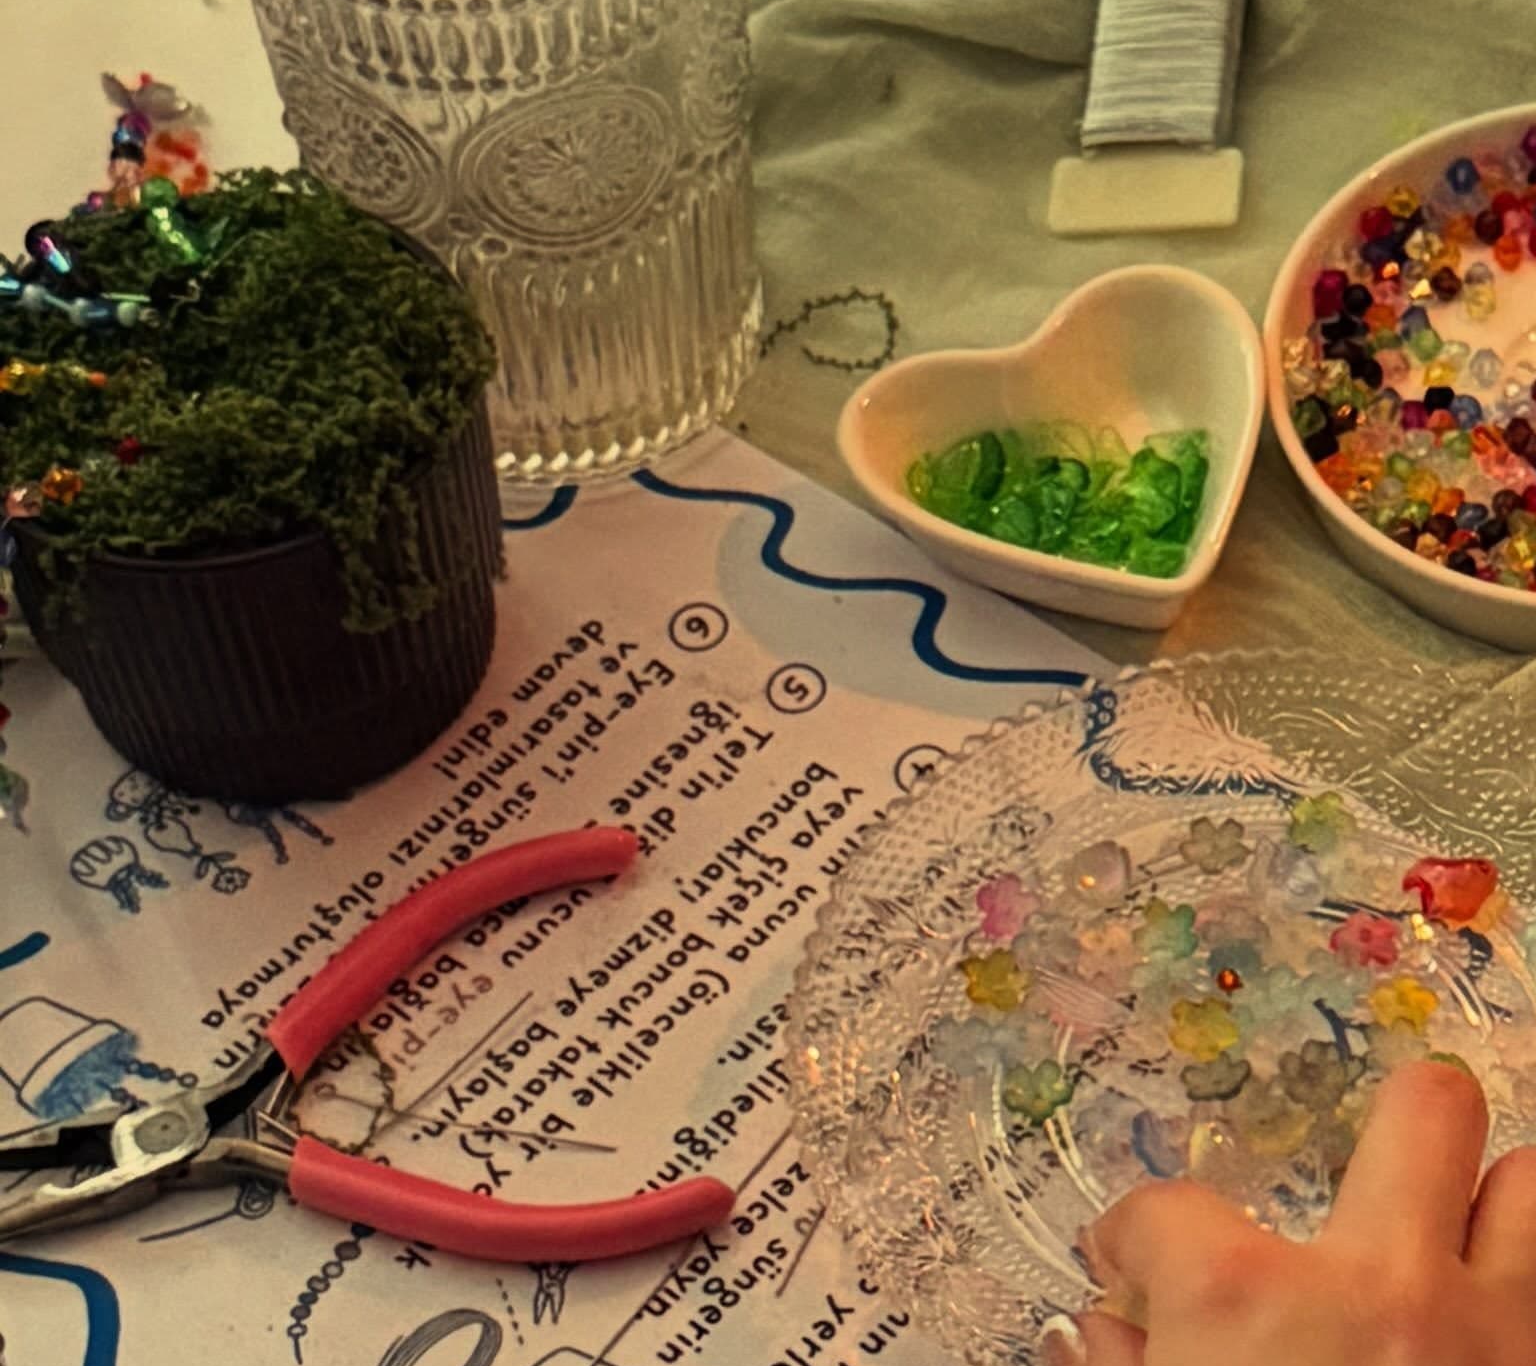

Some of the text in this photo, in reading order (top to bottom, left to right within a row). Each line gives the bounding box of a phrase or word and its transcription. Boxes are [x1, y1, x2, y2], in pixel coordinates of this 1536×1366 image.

[600, 643, 638, 673] ve
[685, 616, 709, 639] 6
[432, 620, 605, 781] devam edin!
[783, 675, 809, 702] 5
[389, 680, 602, 866] tasarımlarınızı
[609, 701, 741, 815] iğnesine
[676, 762, 838, 903] boncukları
[201, 871, 384, 1029] oluşturmaya
[459, 787, 864, 1165] veya çiçek boncuk takarak)
[501, 890, 592, 968] ucunu
[555, 908, 676, 1017] dizmeye
[726, 885, 817, 962] ucuna
[409, 1022, 559, 1141] başlayın.
[572, 969, 730, 1107] (öncelikle
[717, 994, 792, 1064] esin.
[519, 1113, 575, 1162] bir
[656, 1238, 800, 1364] süngerin
